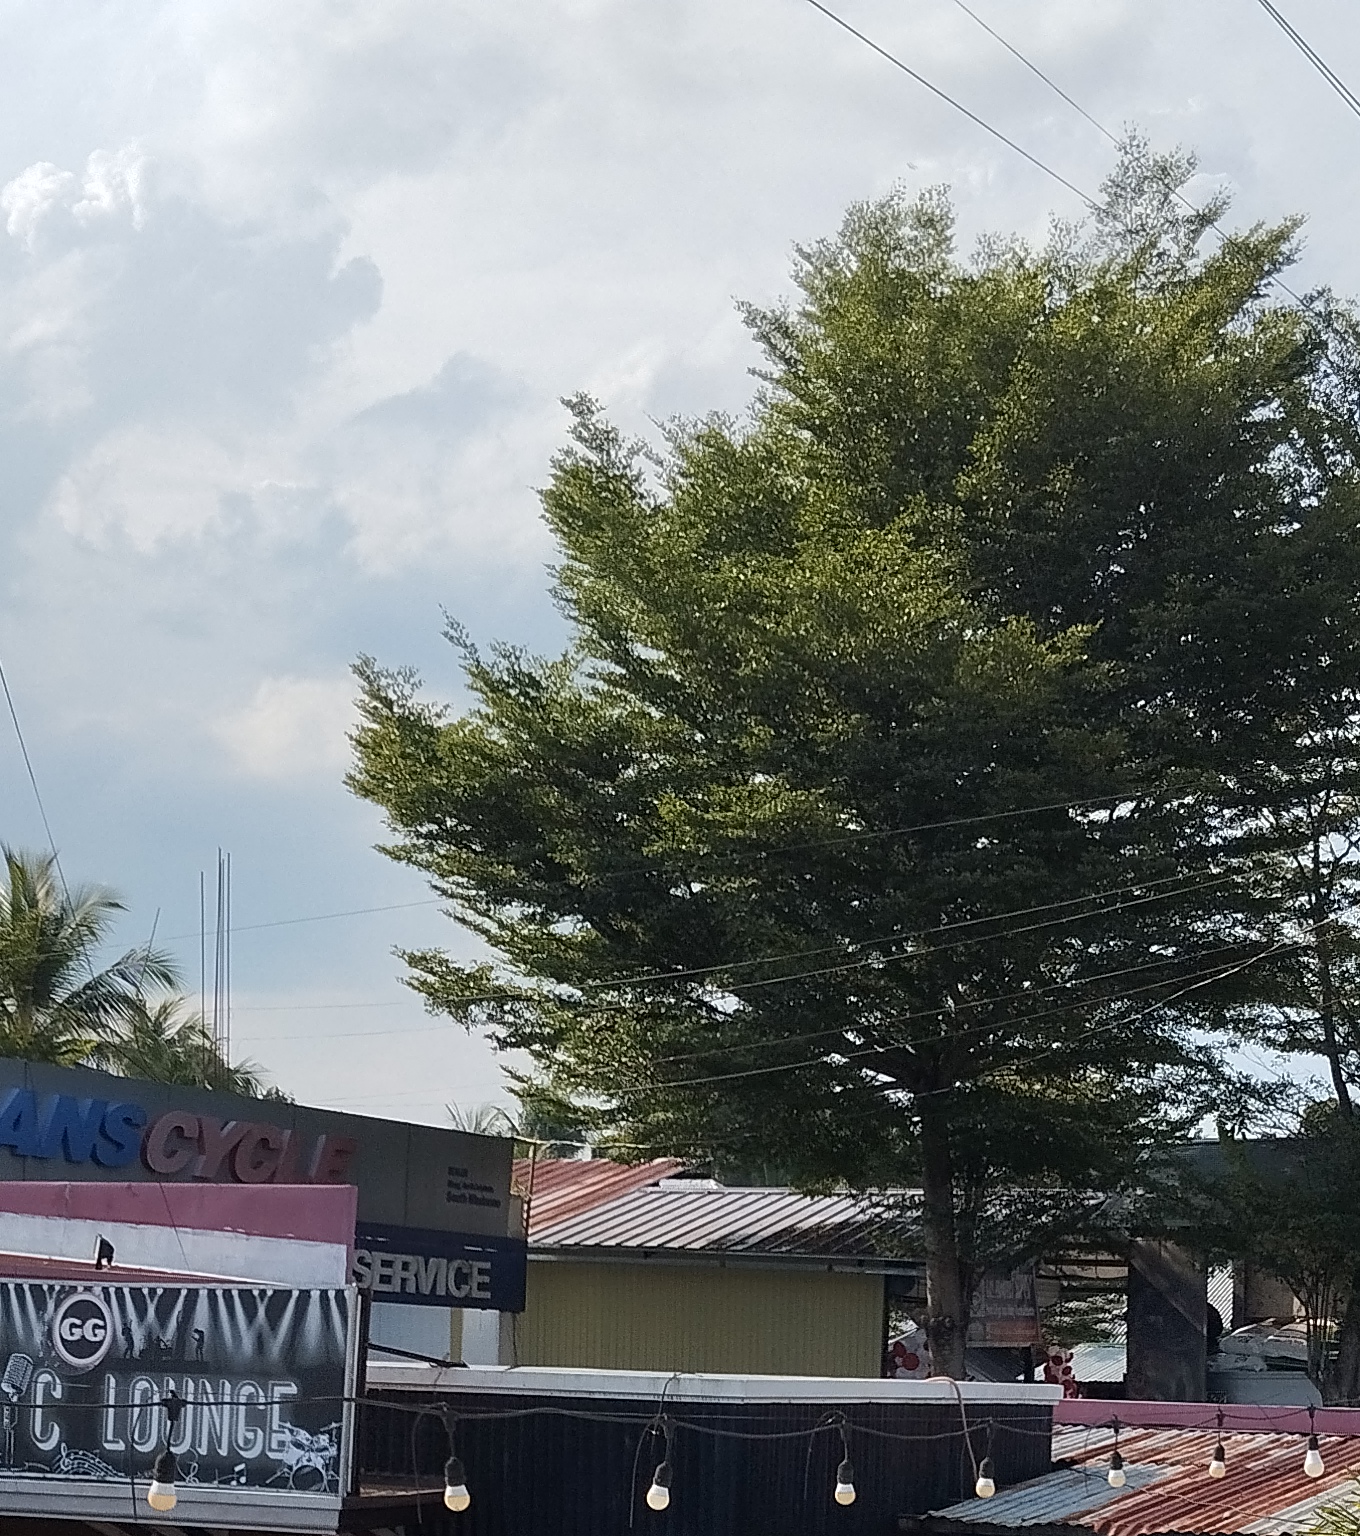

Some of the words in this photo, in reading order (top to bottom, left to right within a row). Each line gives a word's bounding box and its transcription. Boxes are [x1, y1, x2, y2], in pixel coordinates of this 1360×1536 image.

[352, 1249, 491, 1299] SERVICE
[60, 1317, 106, 1342] GG
[100, 1373, 298, 1460] LOUNGE
